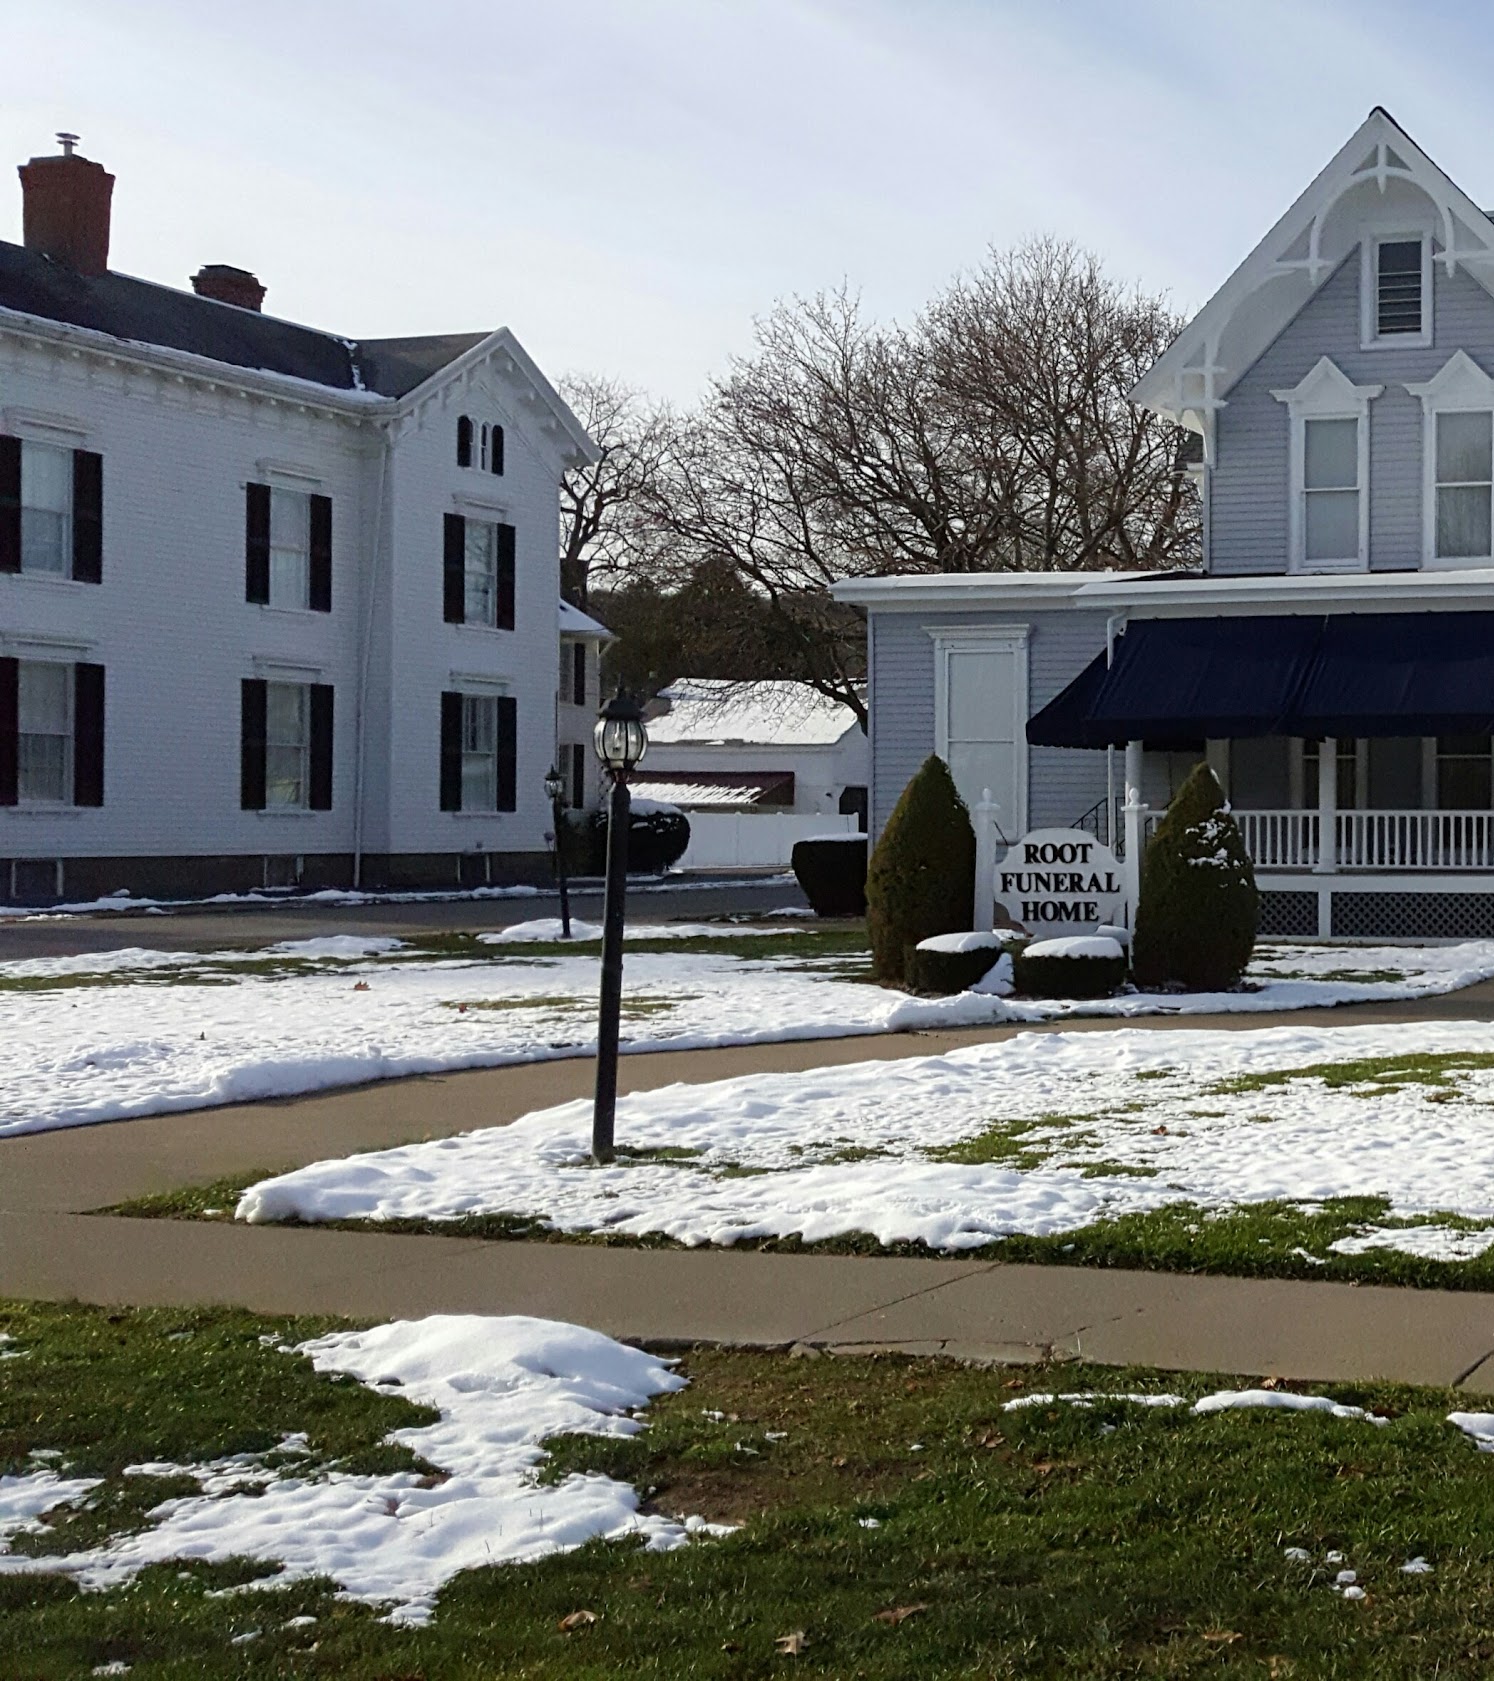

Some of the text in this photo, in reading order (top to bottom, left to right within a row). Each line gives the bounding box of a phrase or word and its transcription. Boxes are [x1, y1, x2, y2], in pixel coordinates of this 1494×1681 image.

[1024, 843, 1093, 864] ROOT
[1000, 872, 1120, 893] FUNERAL
[1021, 901, 1099, 922] HOME
